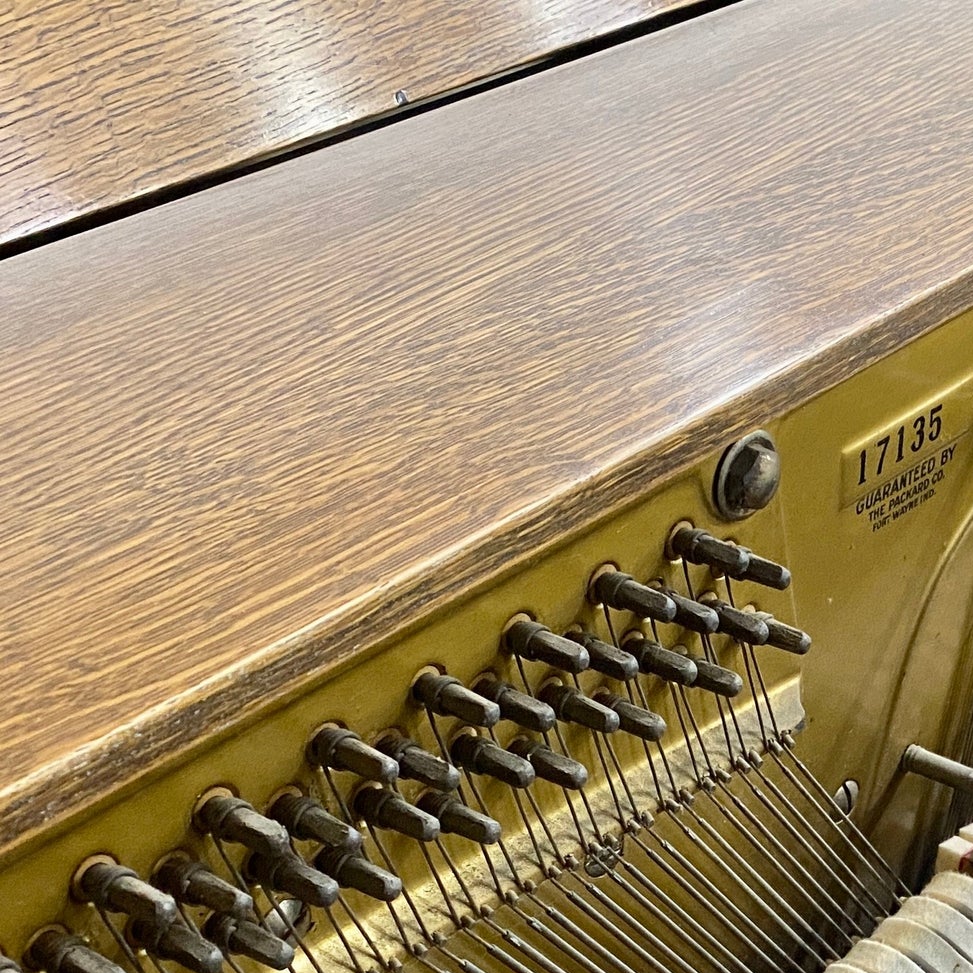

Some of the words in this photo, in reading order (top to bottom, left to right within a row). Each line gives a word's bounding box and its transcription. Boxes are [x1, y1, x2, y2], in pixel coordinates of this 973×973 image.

[858, 404, 943, 485] 17135
[856, 457, 936, 515] GUARANTEED
[940, 443, 957, 466] BY
[868, 505, 885, 522] THE
[888, 479, 930, 512] PACKARD
[931, 470, 945, 485] CO.
[872, 515, 890, 532] FORT
[892, 498, 918, 520] WAYNE
